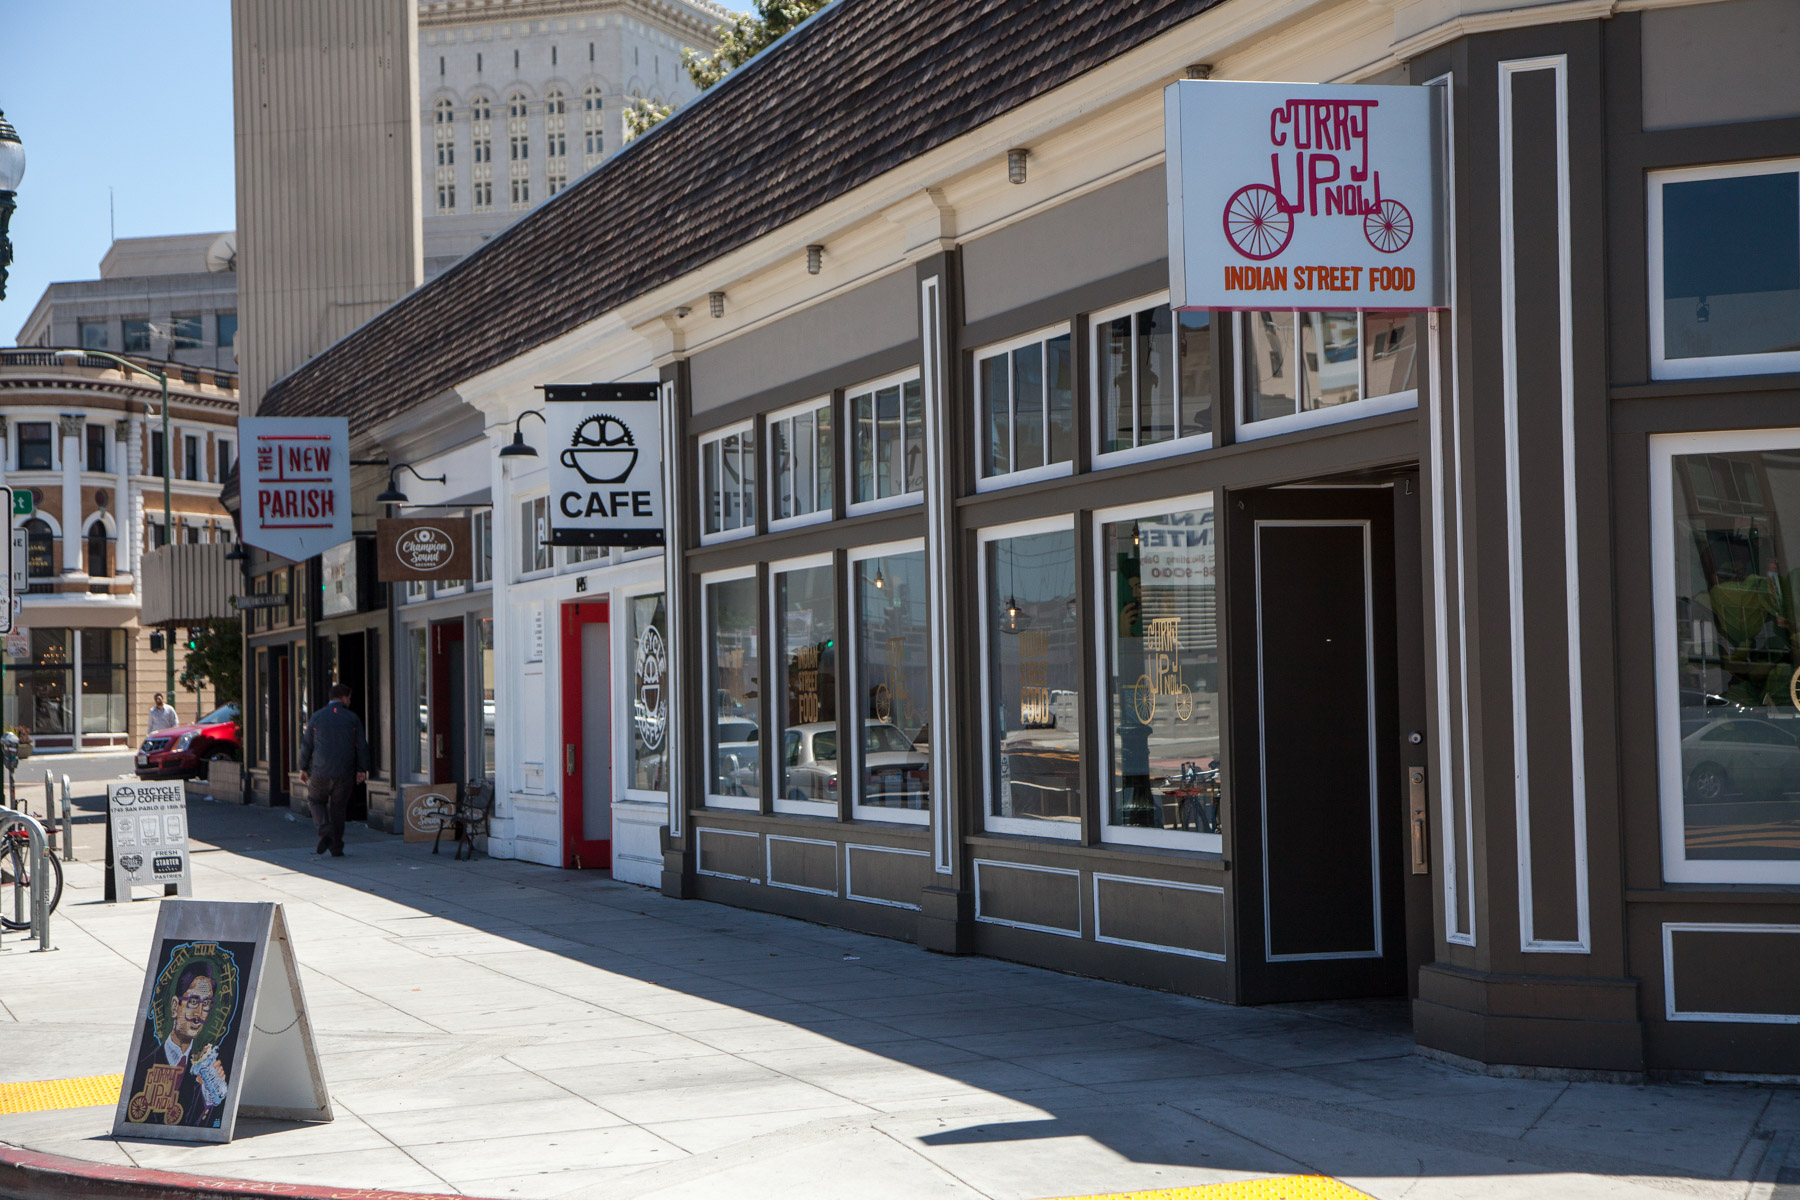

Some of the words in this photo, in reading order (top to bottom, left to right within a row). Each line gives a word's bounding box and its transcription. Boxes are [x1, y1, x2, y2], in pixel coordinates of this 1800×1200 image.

[1270, 98, 1379, 182] CURRY
[1271, 151, 1340, 216] UP
[1324, 170, 1382, 216] NOW
[1224, 265, 1288, 292] INDIAN
[1293, 265, 1363, 292] STREET
[1369, 266, 1416, 292] FOOD
[257, 446, 273, 472] THE
[289, 446, 331, 472] NEW
[258, 489, 335, 518] PARISH
[560, 490, 653, 518] CAFE
[402, 540, 447, 554] Champion
[410, 550, 439, 563] Sound
[1147, 617, 1181, 673] CURRY
[1148, 652, 1170, 696] UP
[799, 693, 818, 723] FOOD
[1021, 688, 1049, 725] FOOD
[137, 786, 180, 796] BICYCLE
[137, 794, 174, 804] COFFEE
